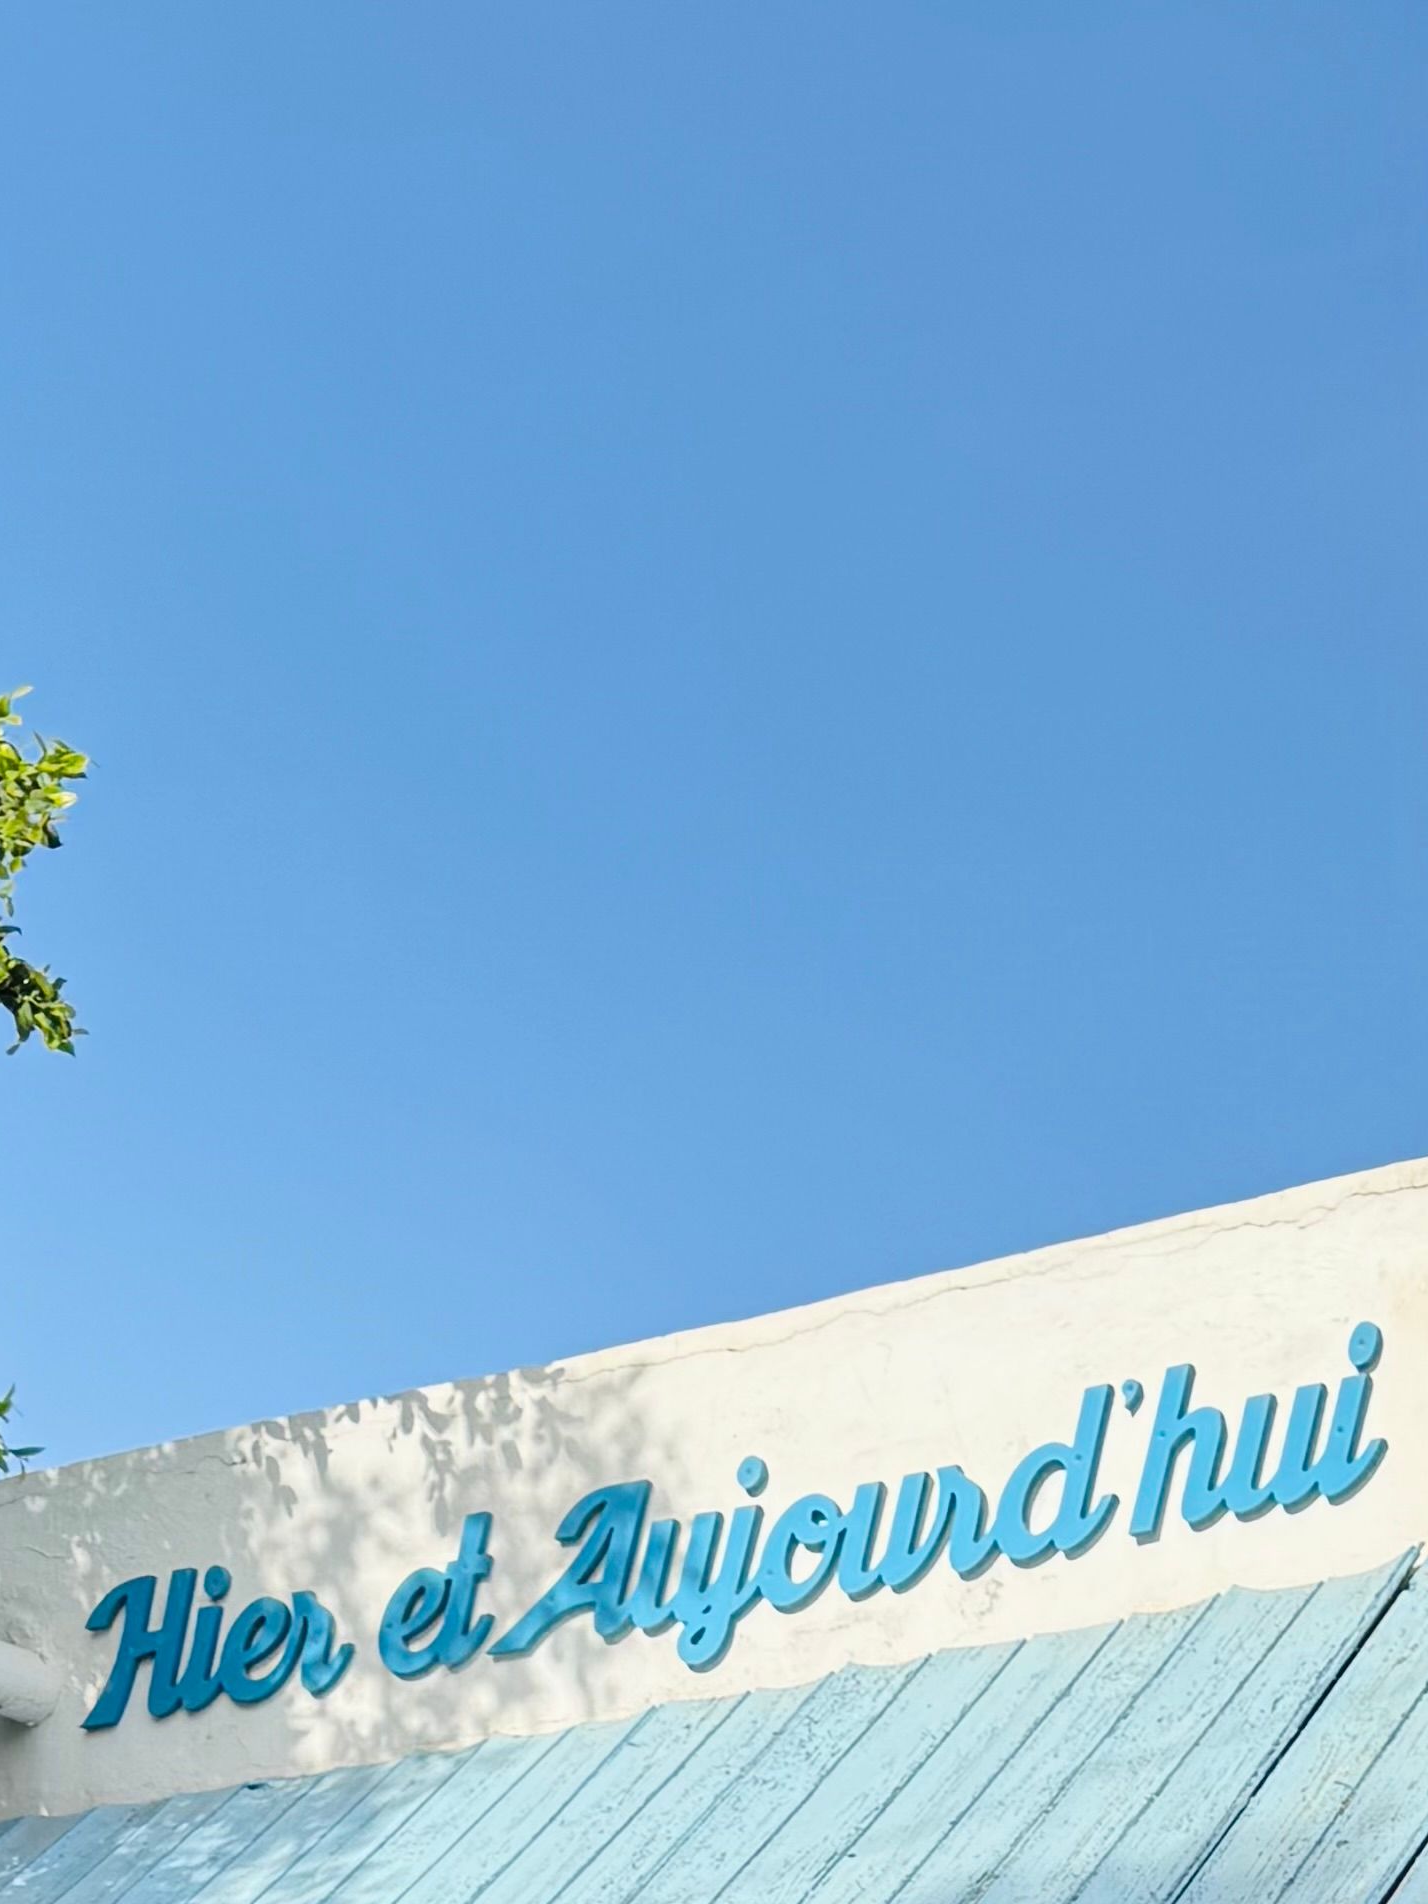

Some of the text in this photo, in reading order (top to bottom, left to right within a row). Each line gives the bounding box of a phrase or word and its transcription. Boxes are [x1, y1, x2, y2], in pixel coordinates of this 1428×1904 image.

[81, 1320, 1389, 1732] Hier et Aujourd'hui
